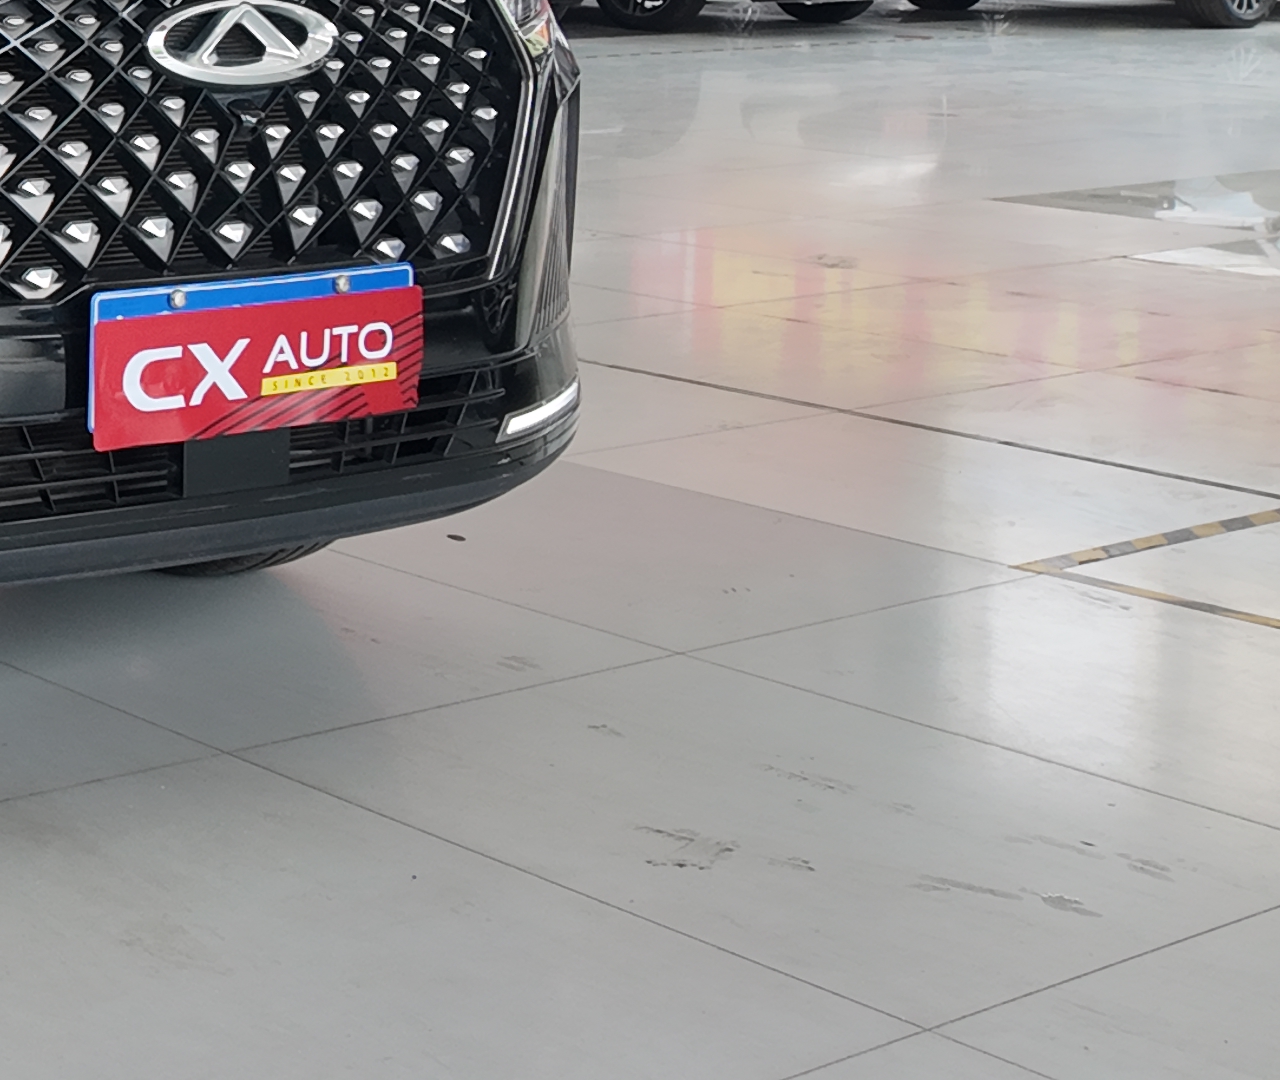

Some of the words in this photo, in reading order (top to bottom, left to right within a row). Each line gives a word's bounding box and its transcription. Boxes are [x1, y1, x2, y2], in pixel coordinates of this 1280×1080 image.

[122, 338, 251, 412] CX
[263, 321, 393, 374] AUTO
[272, 373, 328, 391] SINCE
[344, 366, 391, 382] 2012
